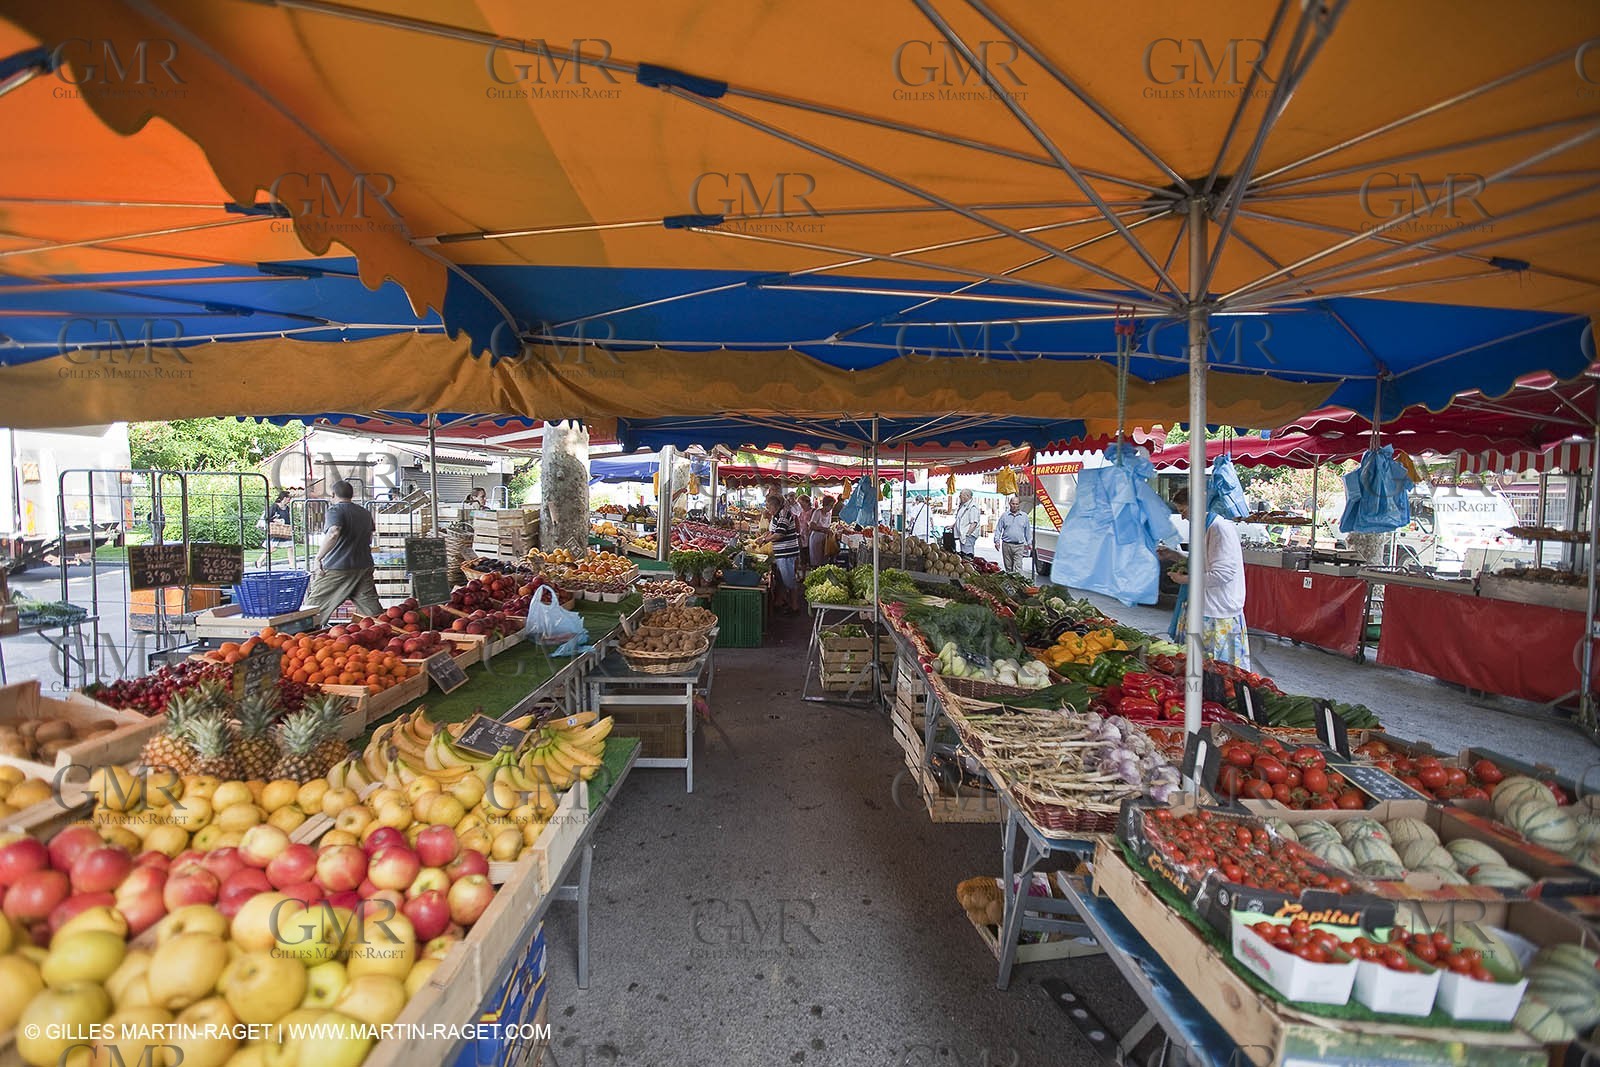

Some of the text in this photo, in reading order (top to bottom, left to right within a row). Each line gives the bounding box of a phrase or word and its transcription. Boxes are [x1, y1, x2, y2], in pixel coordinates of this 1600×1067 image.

[1031, 464, 1079, 475] CHARCUTERIE
[1036, 489, 1064, 532] L'ARIEGEOI
[1273, 900, 1361, 925] Capital
